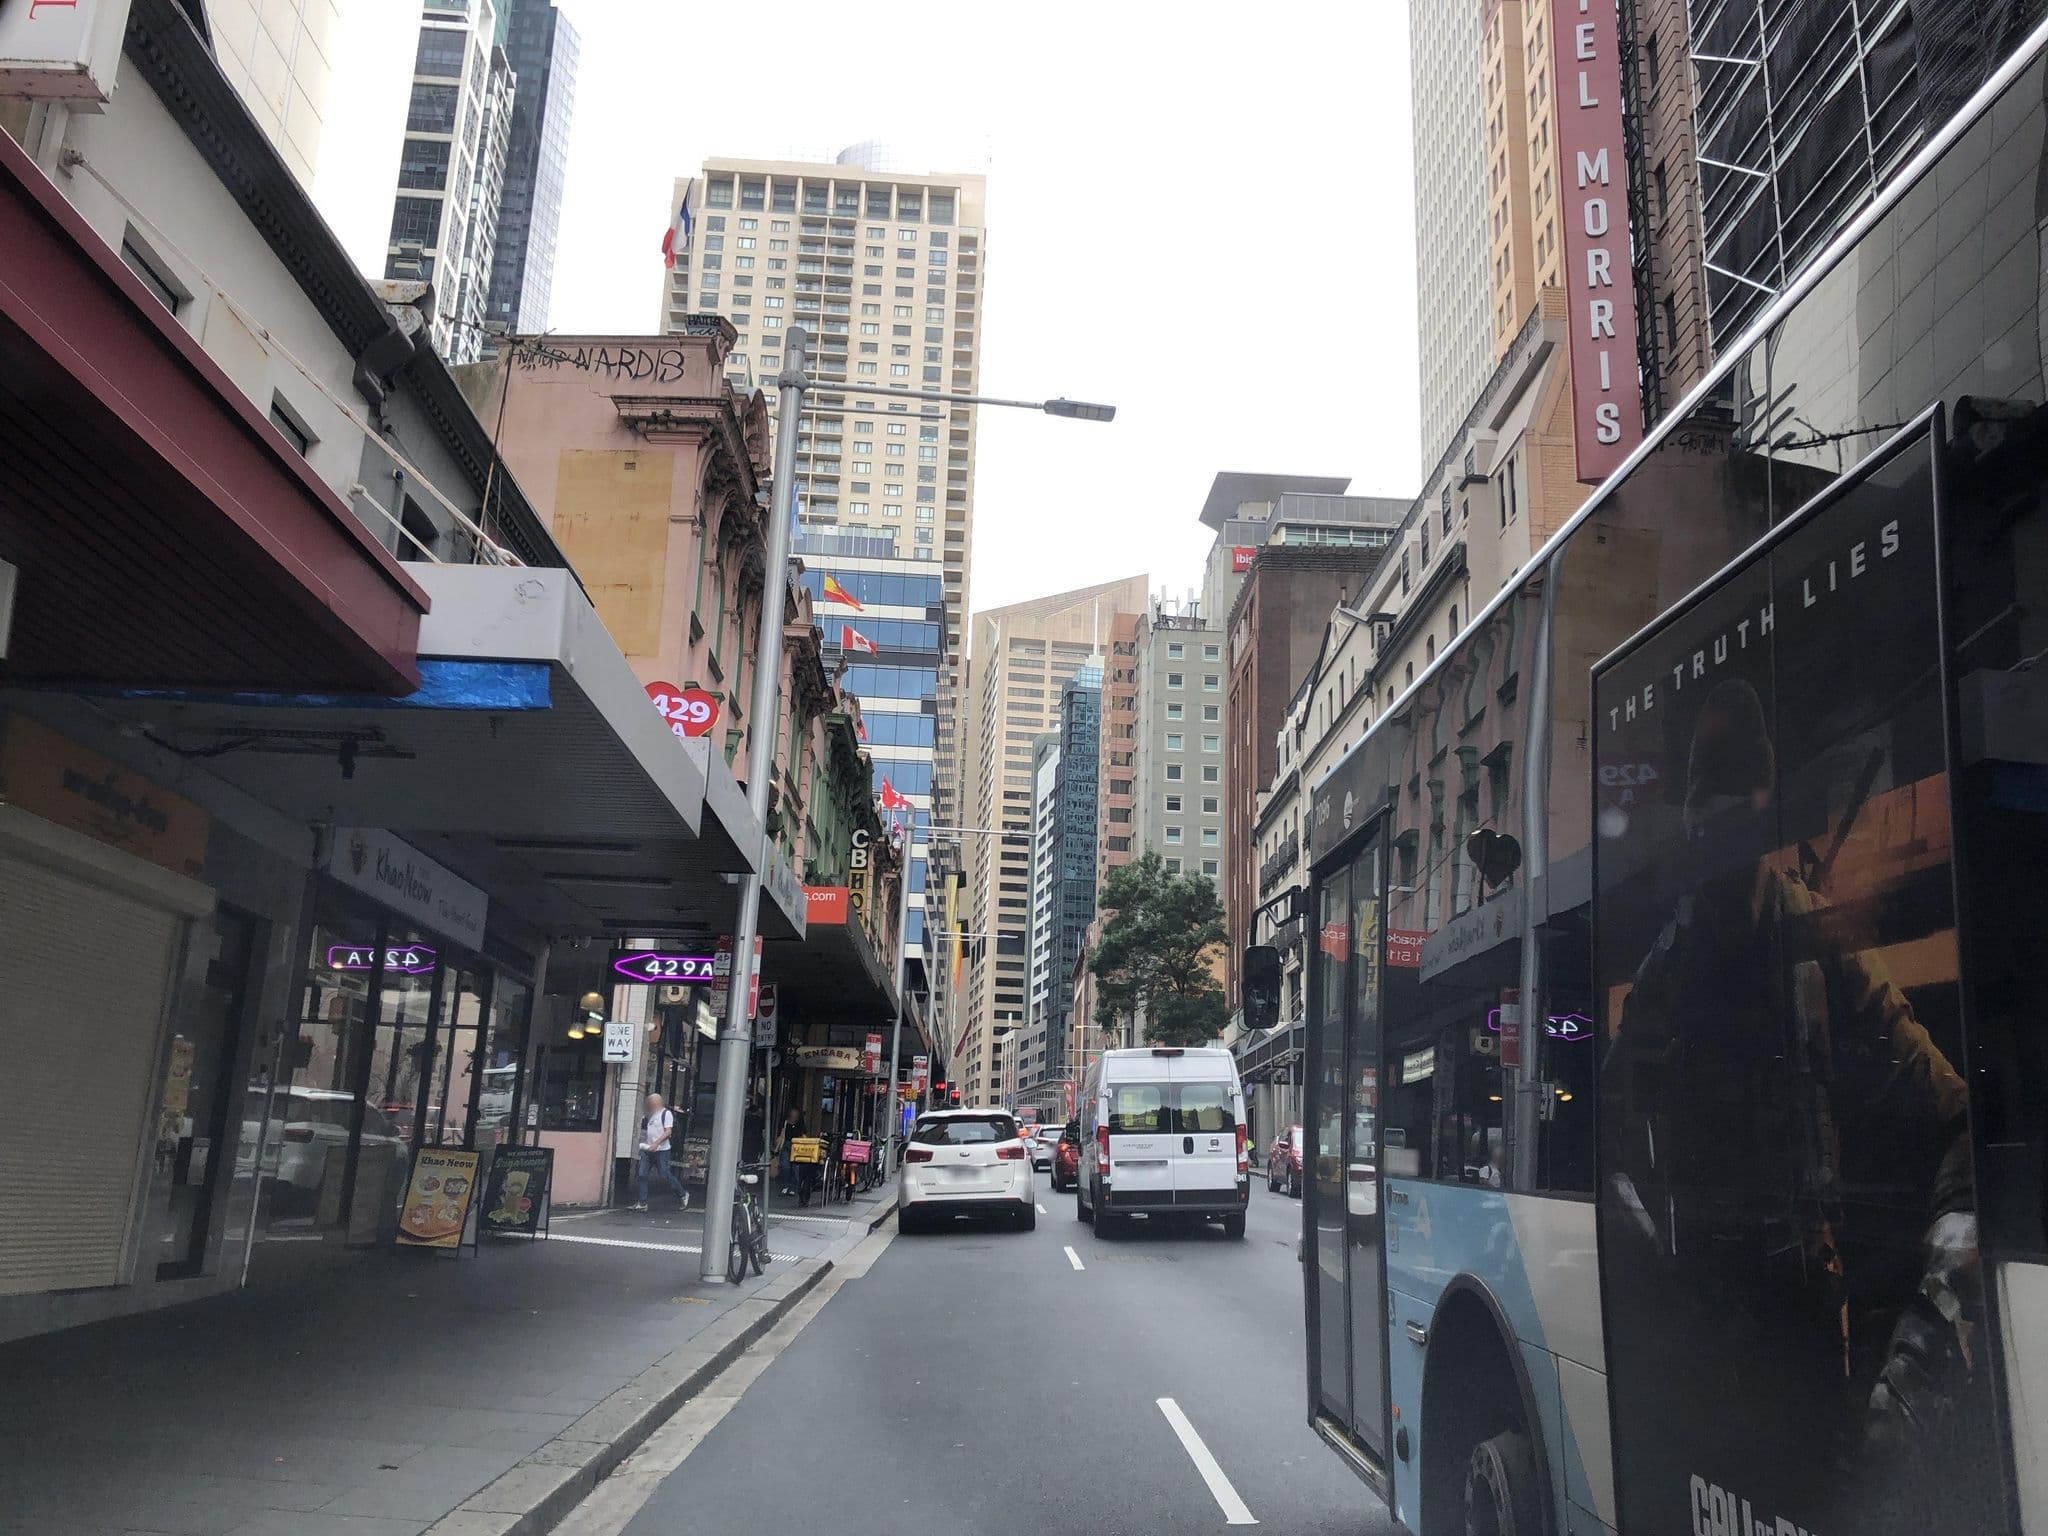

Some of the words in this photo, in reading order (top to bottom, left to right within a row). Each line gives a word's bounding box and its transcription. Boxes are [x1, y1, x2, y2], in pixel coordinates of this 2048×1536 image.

[1576, 148, 1621, 446] MORRIS
[1609, 683, 1655, 732] THE
[1673, 602, 1776, 690] TRUTH
[1803, 519, 1900, 609] LIES
[653, 694, 711, 724] 429
[671, 722, 686, 737] A
[851, 829, 870, 868] CB
[608, 1038, 632, 1048] WAY
[610, 1026, 630, 1036] ONE
